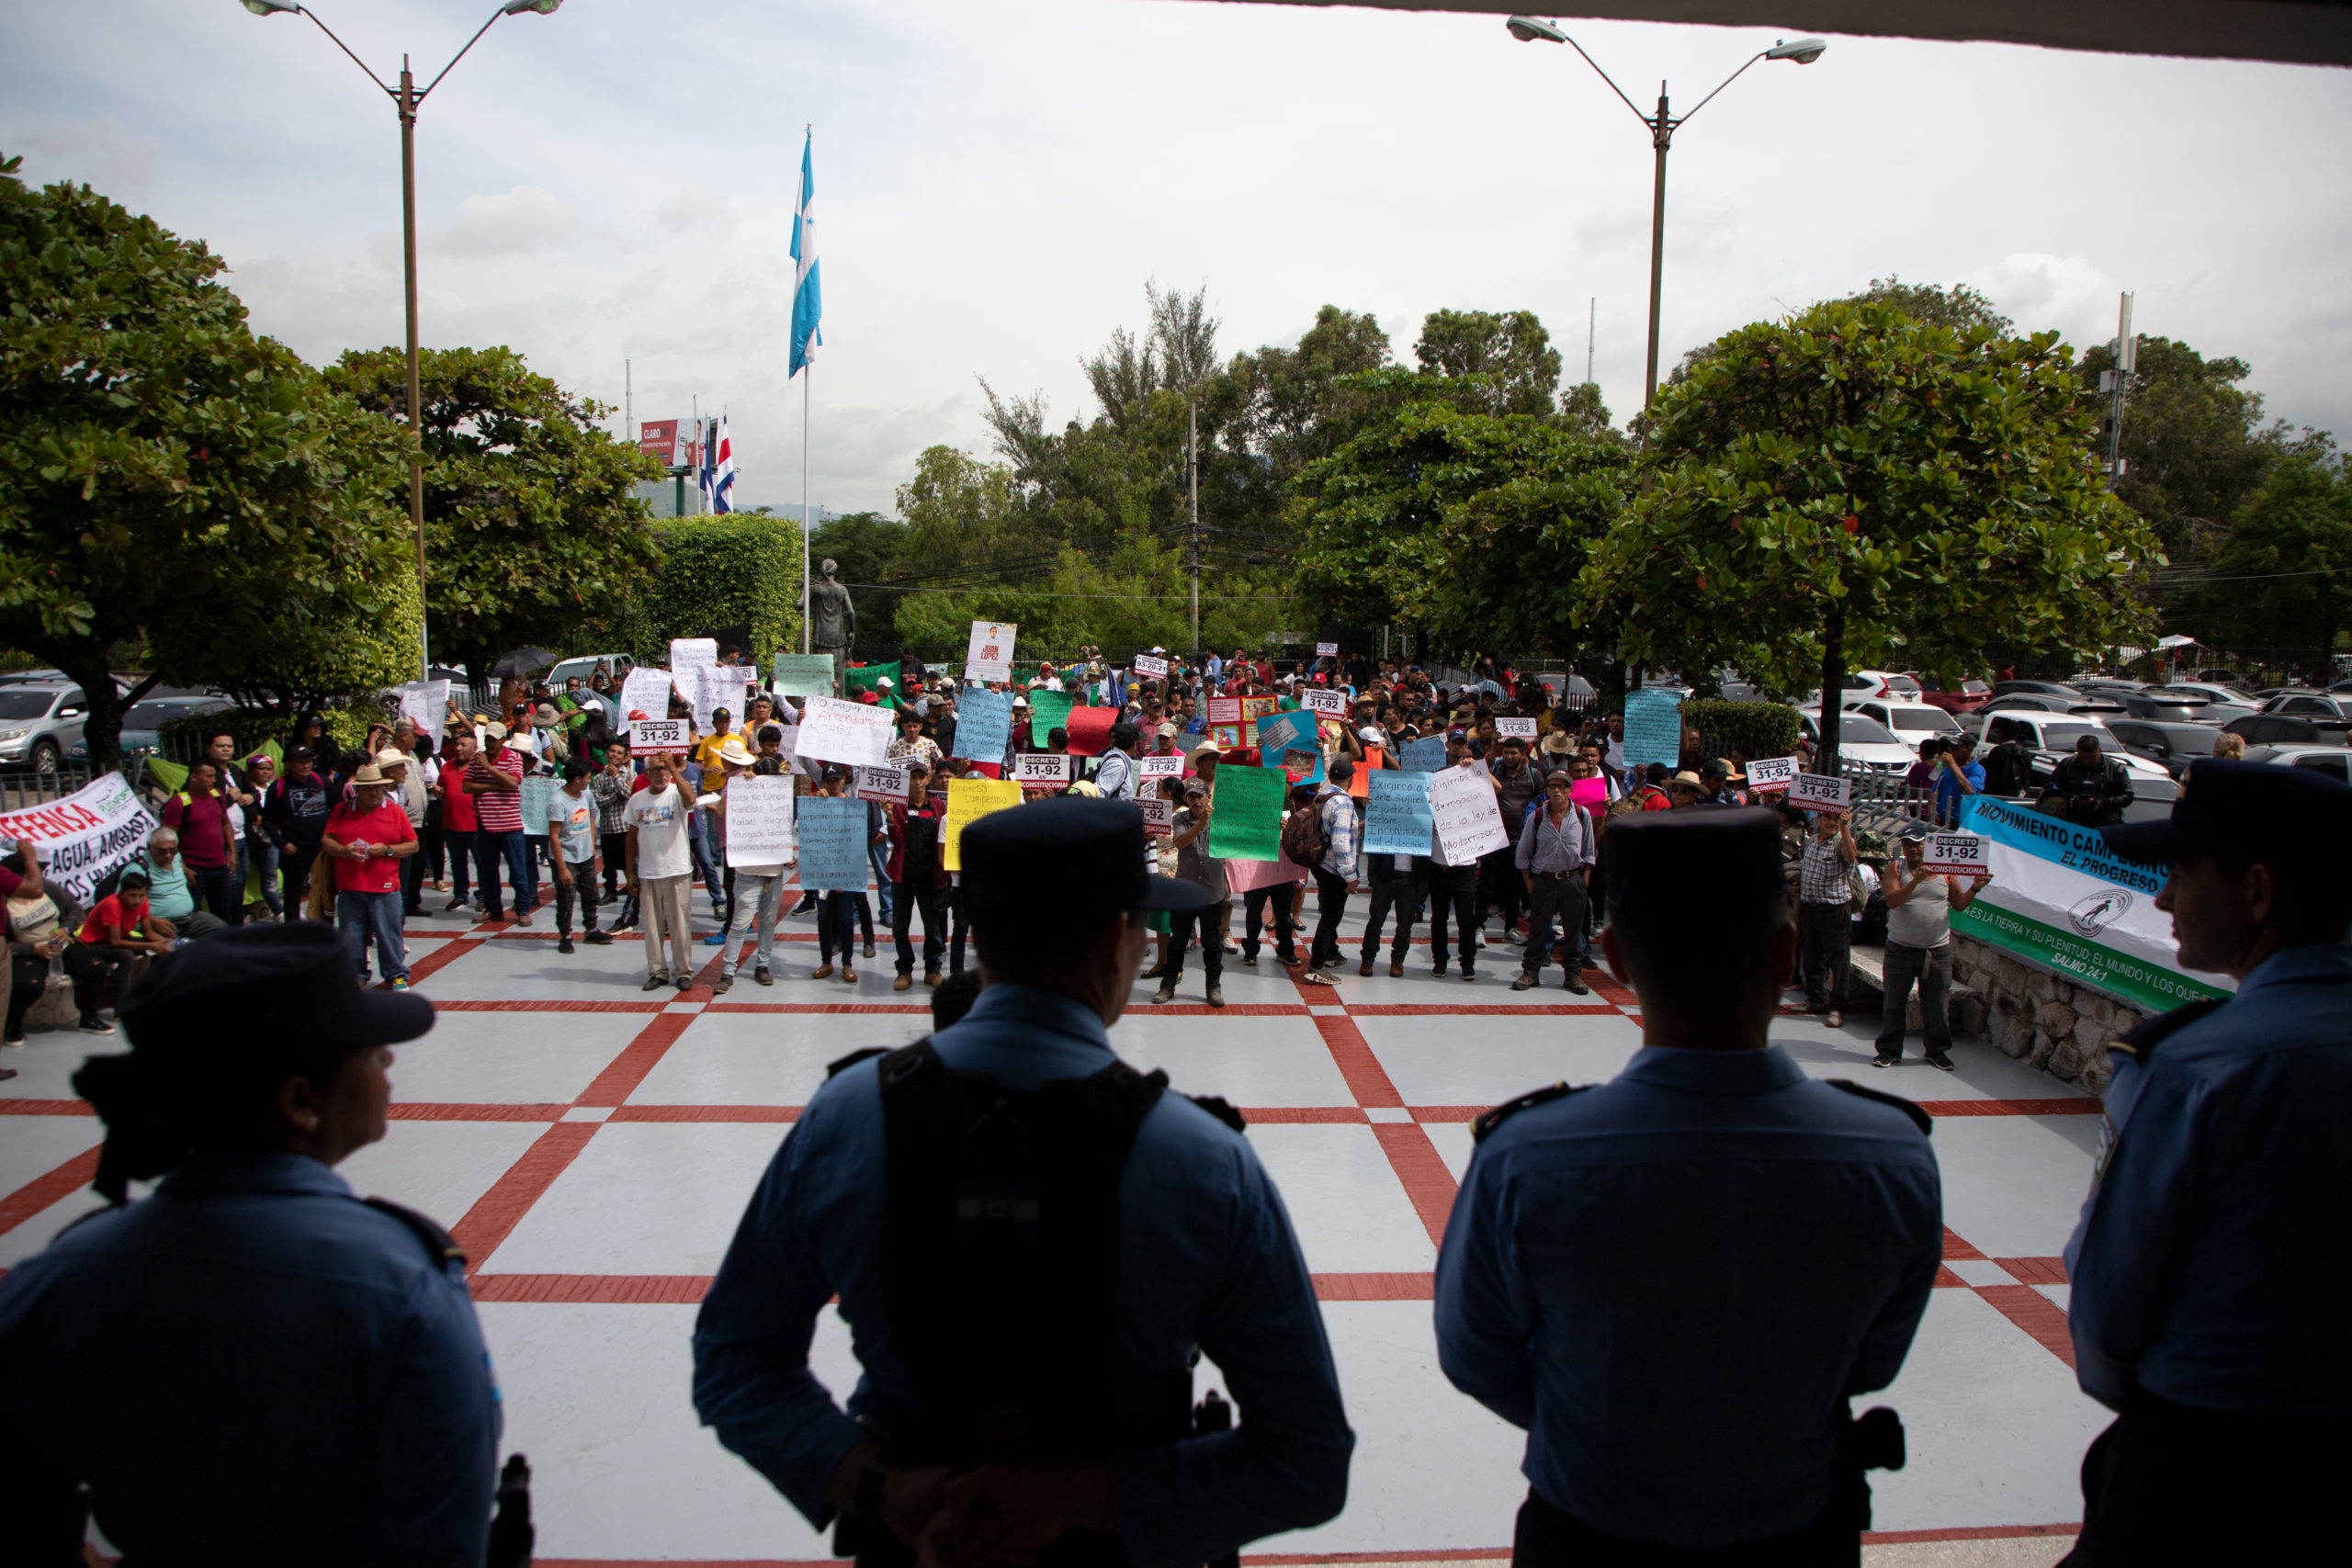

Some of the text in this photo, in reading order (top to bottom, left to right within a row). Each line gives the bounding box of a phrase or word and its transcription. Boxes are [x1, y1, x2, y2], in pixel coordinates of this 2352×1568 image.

[644, 428, 661, 439] CLARO
[1137, 661, 1166, 672] 93-20-21
[1310, 691, 1338, 700] DECRETO
[808, 697, 827, 707] NO
[1309, 698, 1338, 709] 31-92
[640, 730, 680, 741] 31-92
[1024, 764, 1061, 775] 31-92
[1472, 765, 1483, 777] la
[1756, 760, 1788, 770] DECRETO
[869, 768, 900, 779] DECRETO
[1757, 768, 1792, 780] 31-92
[867, 775, 901, 790] 31-92
[1802, 776, 1838, 788] DECRETO
[950, 781, 988, 796] Empresa
[1799, 784, 1839, 799] 31-92
[0, 803, 105, 843] EFENSA
[1440, 818, 1452, 830] de
[1472, 810, 1485, 821] ley
[1488, 805, 1498, 816] de
[1975, 801, 2069, 845] MOVIMIENTO
[51, 840, 96, 874] AGUA,
[1935, 846, 1979, 860] 31-92
[2060, 851, 2158, 893] EL PROGRESO
[1970, 908, 1983, 919] ES
[1983, 911, 1994, 924] LA
[1994, 916, 2023, 934] TIERRA
[2023, 927, 2032, 937] Y
[2032, 930, 2045, 943] SU
[2093, 952, 2104, 967] EL
[2106, 957, 2143, 981] MUNDO
[2144, 972, 2154, 985] Y
[2154, 976, 2175, 994] LOS
[2051, 952, 2109, 983] SALMO 24:1
